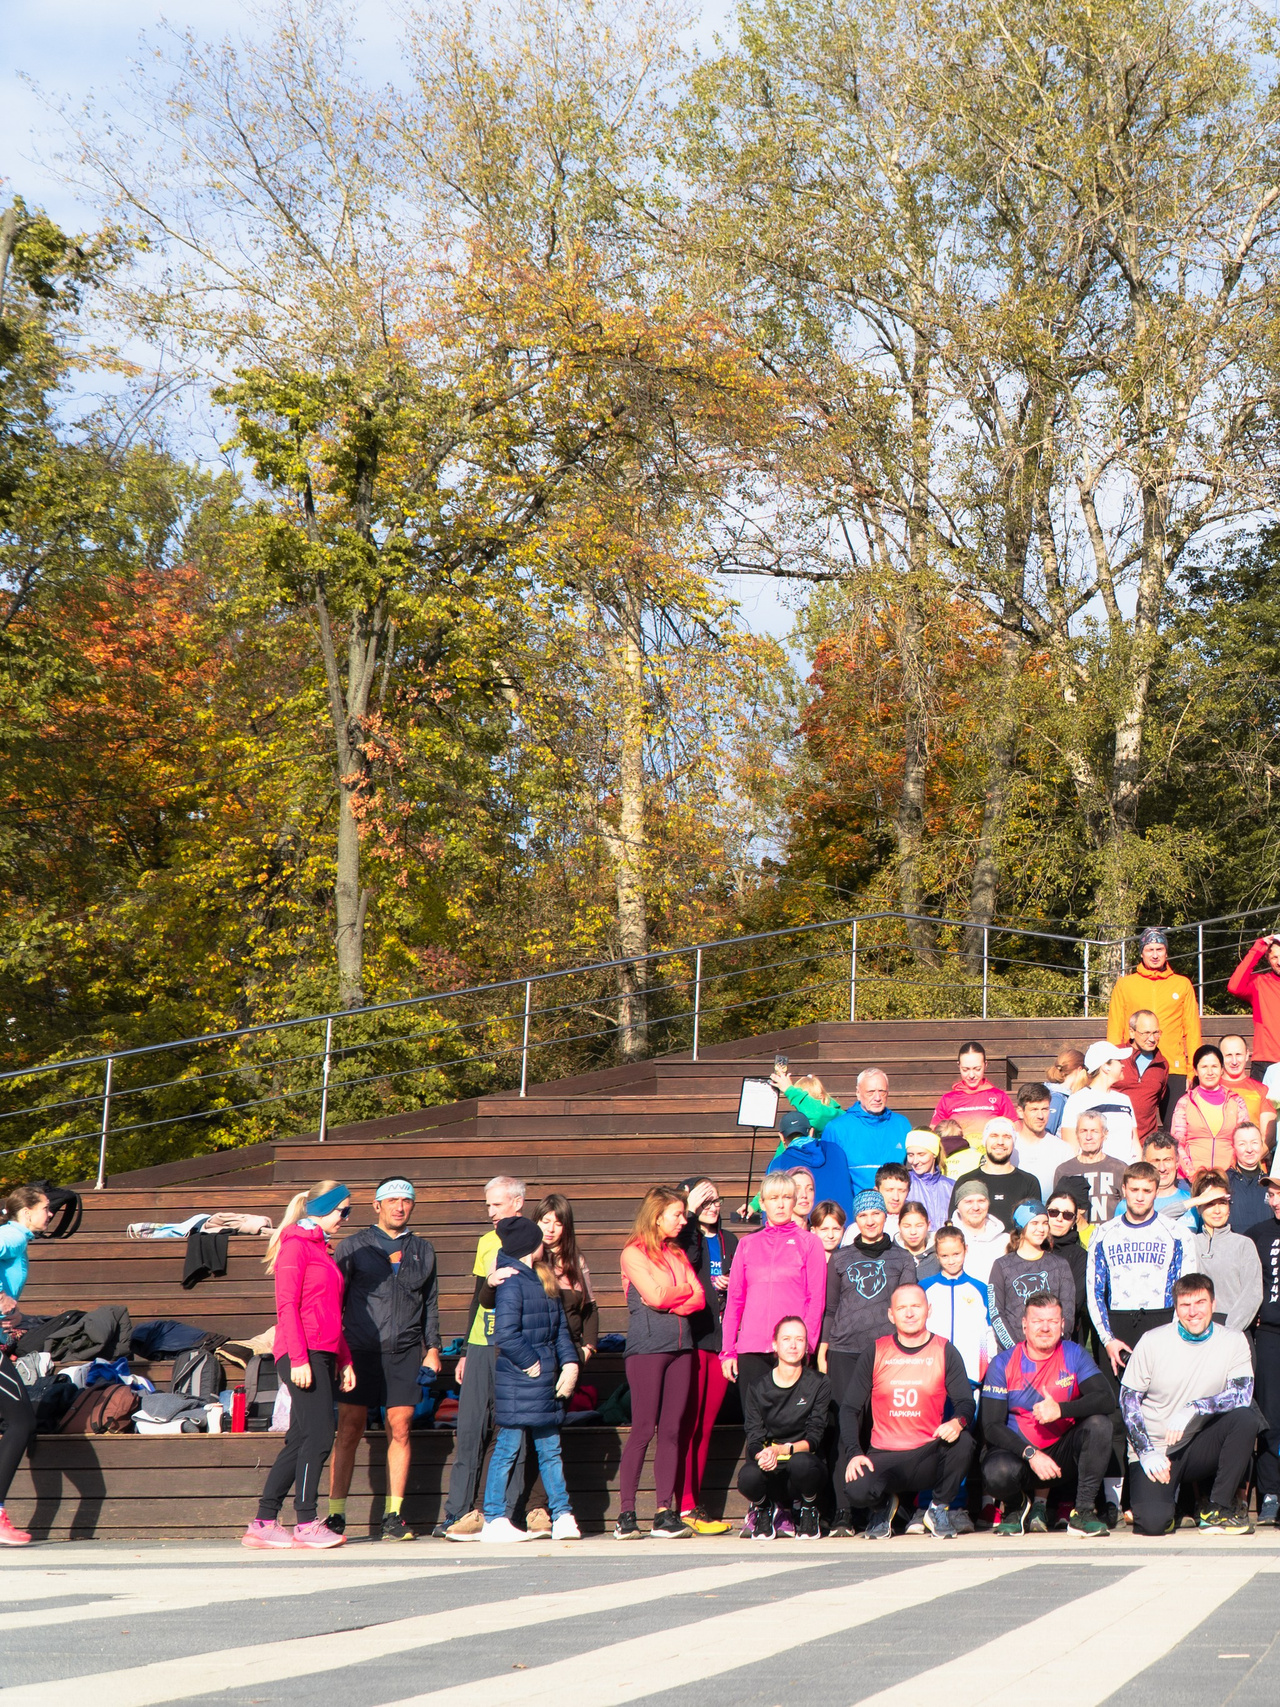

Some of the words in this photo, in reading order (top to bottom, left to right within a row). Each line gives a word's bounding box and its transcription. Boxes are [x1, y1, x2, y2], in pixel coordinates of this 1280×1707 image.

[1074, 1172, 1114, 1195] TR
[1108, 1241, 1167, 1256] HARDCORE
[1110, 1252, 1166, 1266] TRAINING
[892, 1388, 918, 1408] 50
